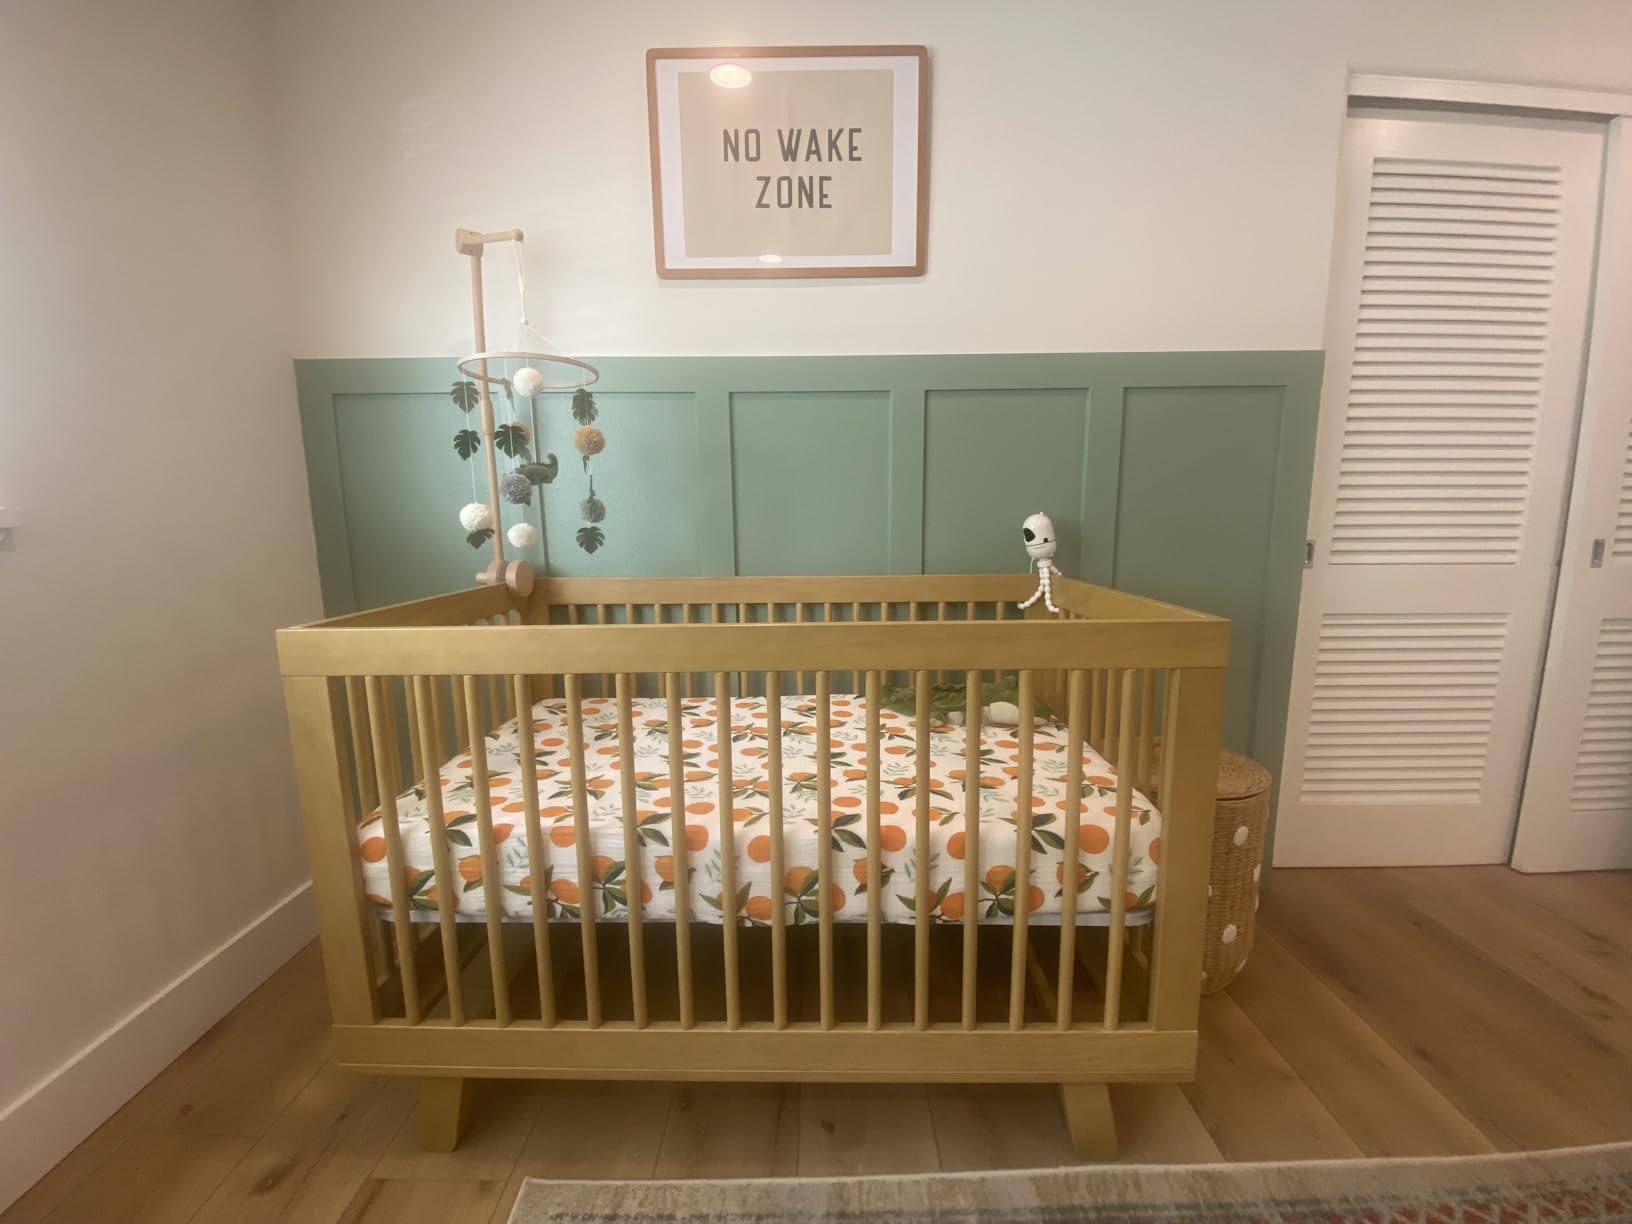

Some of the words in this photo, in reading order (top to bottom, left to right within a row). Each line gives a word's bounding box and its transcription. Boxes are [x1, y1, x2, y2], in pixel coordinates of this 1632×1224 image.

[722, 128, 761, 162] NO
[777, 128, 863, 162] WAKE
[755, 175, 832, 209] ZONE
